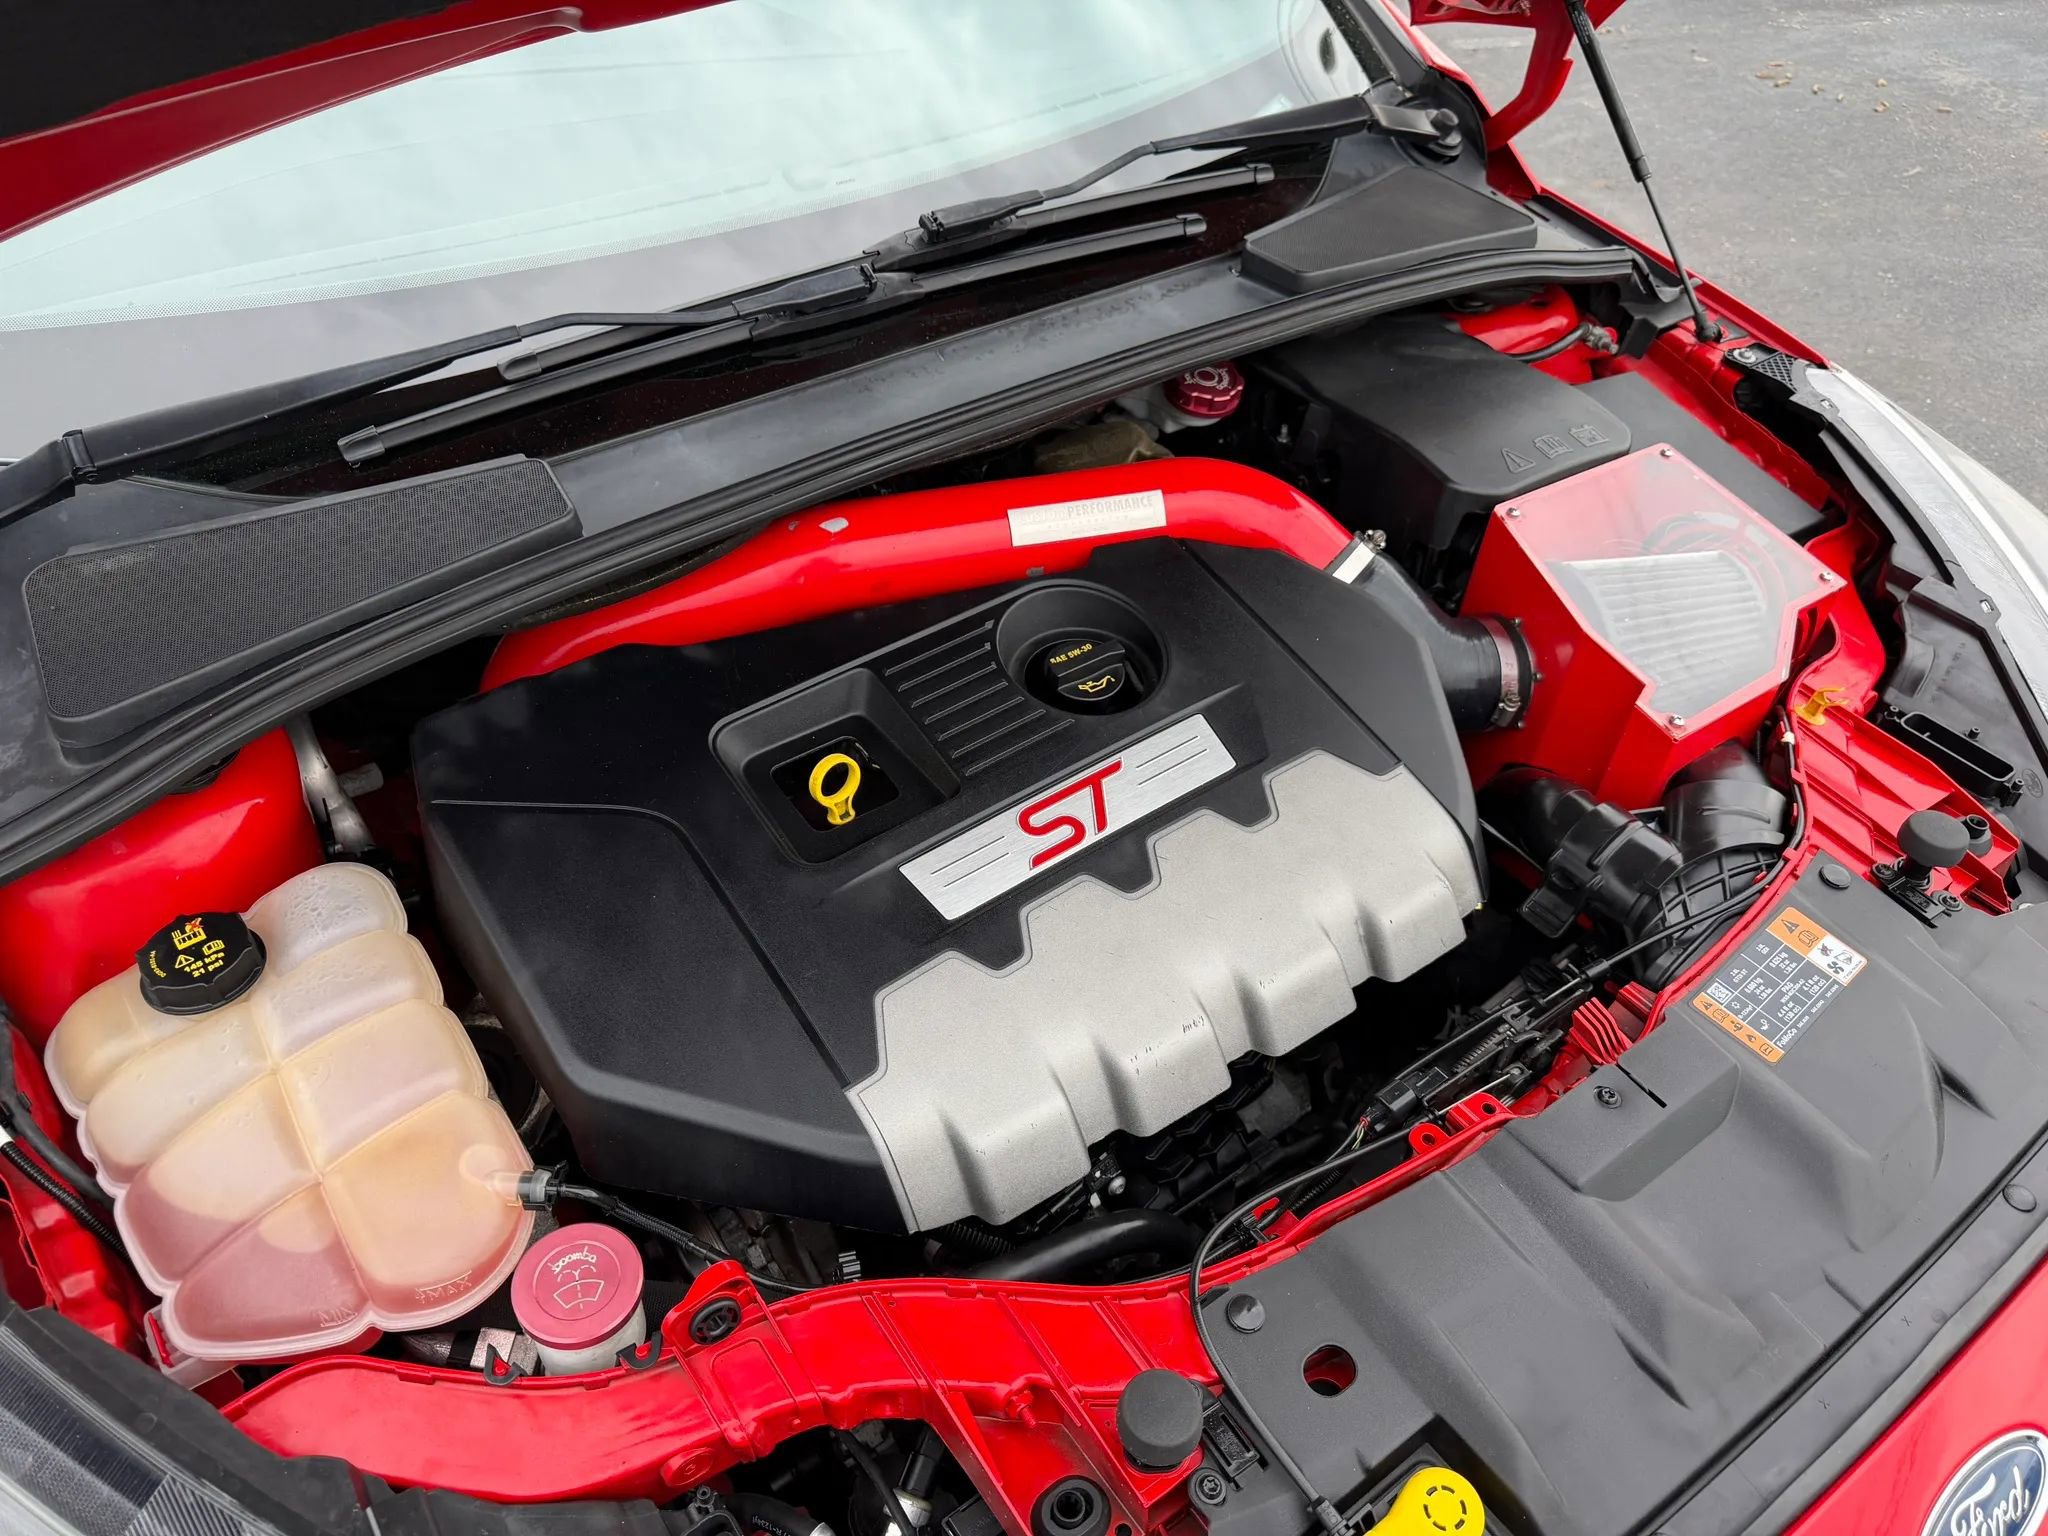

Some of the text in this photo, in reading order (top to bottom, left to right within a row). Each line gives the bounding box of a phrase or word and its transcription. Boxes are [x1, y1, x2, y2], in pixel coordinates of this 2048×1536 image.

[1068, 495, 1153, 519] PERFORMANCE
[1049, 643, 1093, 664] SAE 5W-30
[1017, 757, 1123, 870] ST
[184, 952, 225, 973] 145 kPa
[192, 960, 224, 978] 21 psi
[1780, 980, 1793, 993] PAG
[1775, 1026, 1798, 1048] FoMoCo
[548, 1246, 597, 1274] boomba
[428, 1276, 472, 1301] MAX
[319, 1306, 353, 1327] MIN
[1951, 1465, 2030, 1536] Ford
